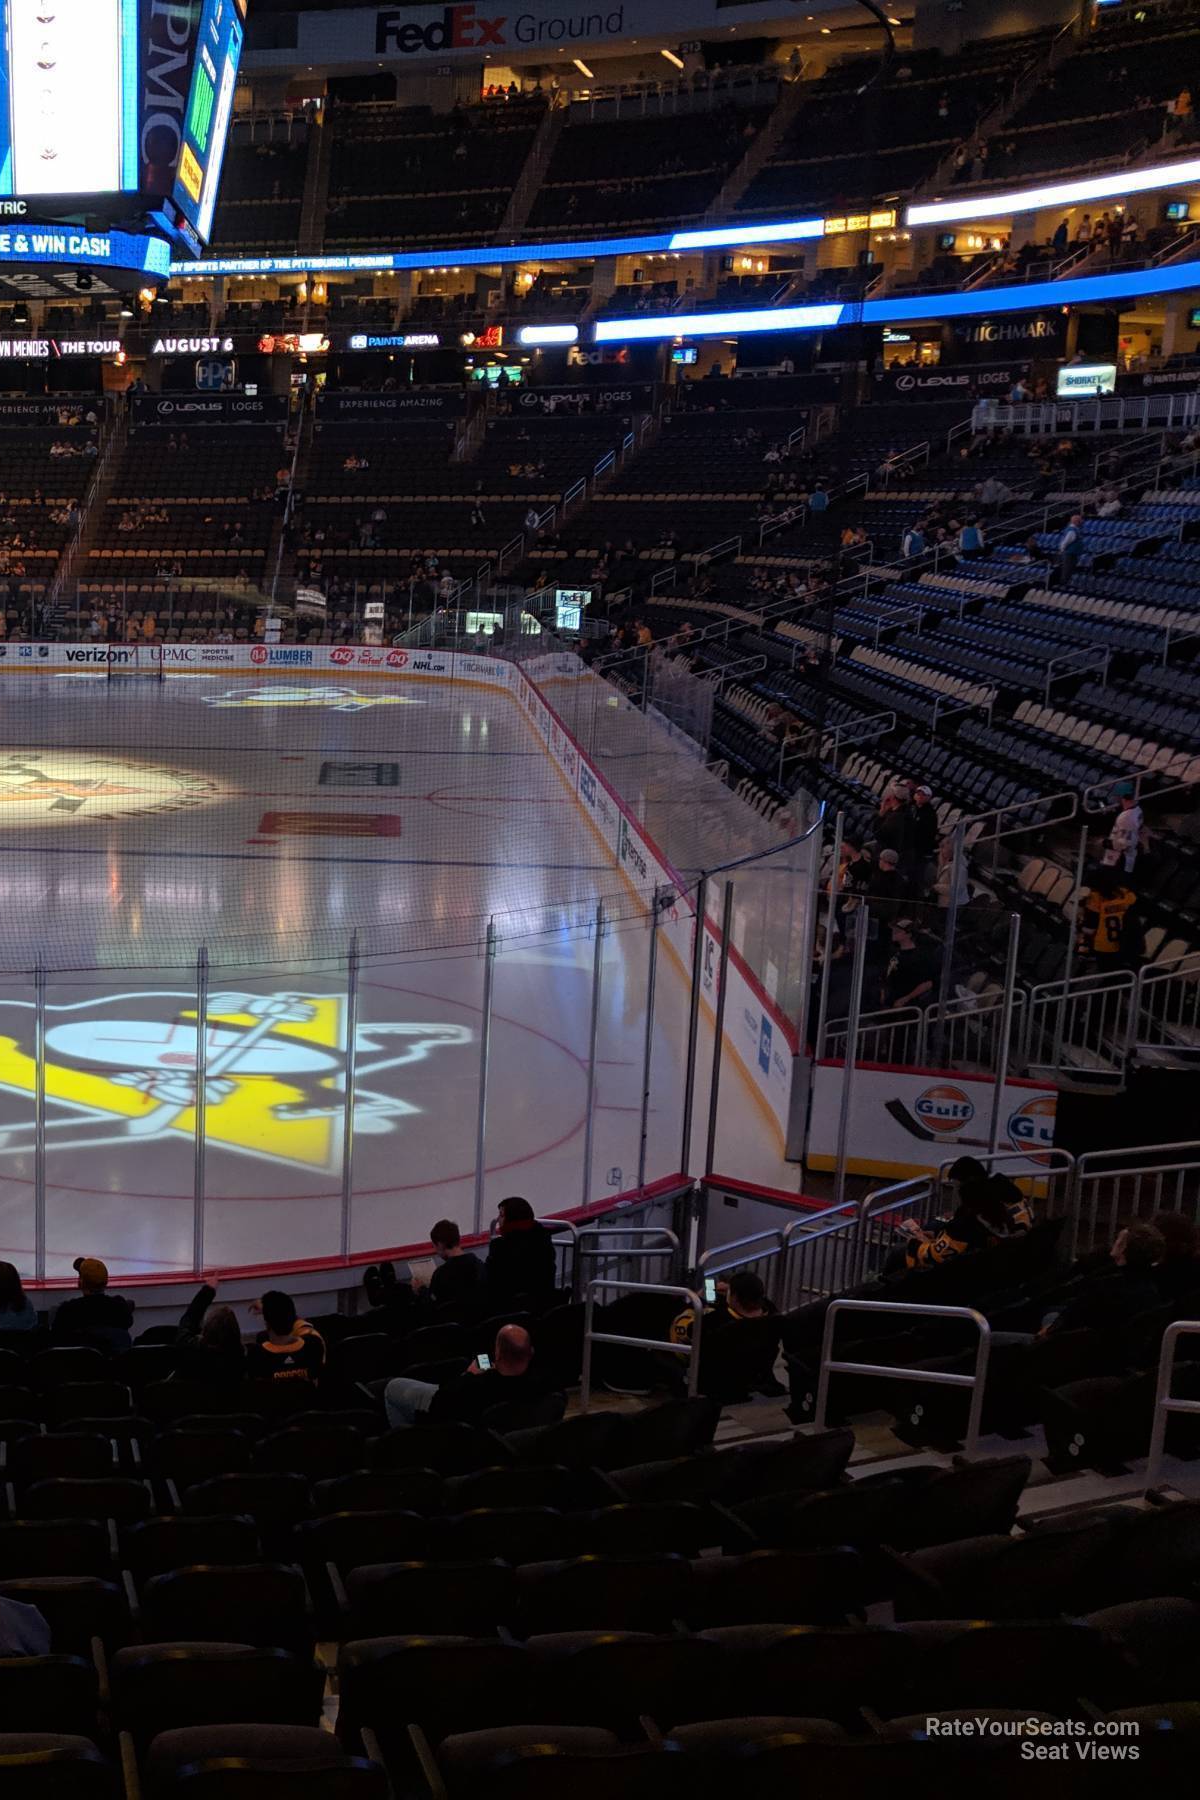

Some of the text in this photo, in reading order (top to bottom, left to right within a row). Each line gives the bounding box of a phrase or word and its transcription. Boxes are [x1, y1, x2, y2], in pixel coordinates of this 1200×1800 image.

[375, 5, 624, 54] FedEx Ground
[14, 234, 29, 252] &
[32, 235, 65, 254] WIN
[69, 236, 111, 257] CASH
[219, 260, 259, 270] PARTNER
[260, 259, 274, 269] OF
[274, 259, 291, 269] THE
[292, 258, 348, 268] PITTSBURGH
[965, 320, 1057, 342] HIGHMARK
[61, 341, 121, 353] THE TOUR
[153, 337, 234, 353] AUGUST 6
[368, 337, 404, 347] PAINTS
[404, 334, 439, 346] ARENA
[13, 340, 49, 356] MENDES
[917, 372, 1010, 387] LEXUS LOGES
[175, 402, 263, 411] LEXUS LOGES
[340, 398, 443, 408] EXPERIENCE AMAZING
[65, 647, 128, 663] verizon
[150, 648, 196, 662] UPMC
[251, 648, 267, 661] 84
[269, 650, 313, 661] LUMBER
[334, 650, 350, 660] DQ
[389, 653, 406, 663] DQ
[917, 1100, 971, 1117] Gulf
